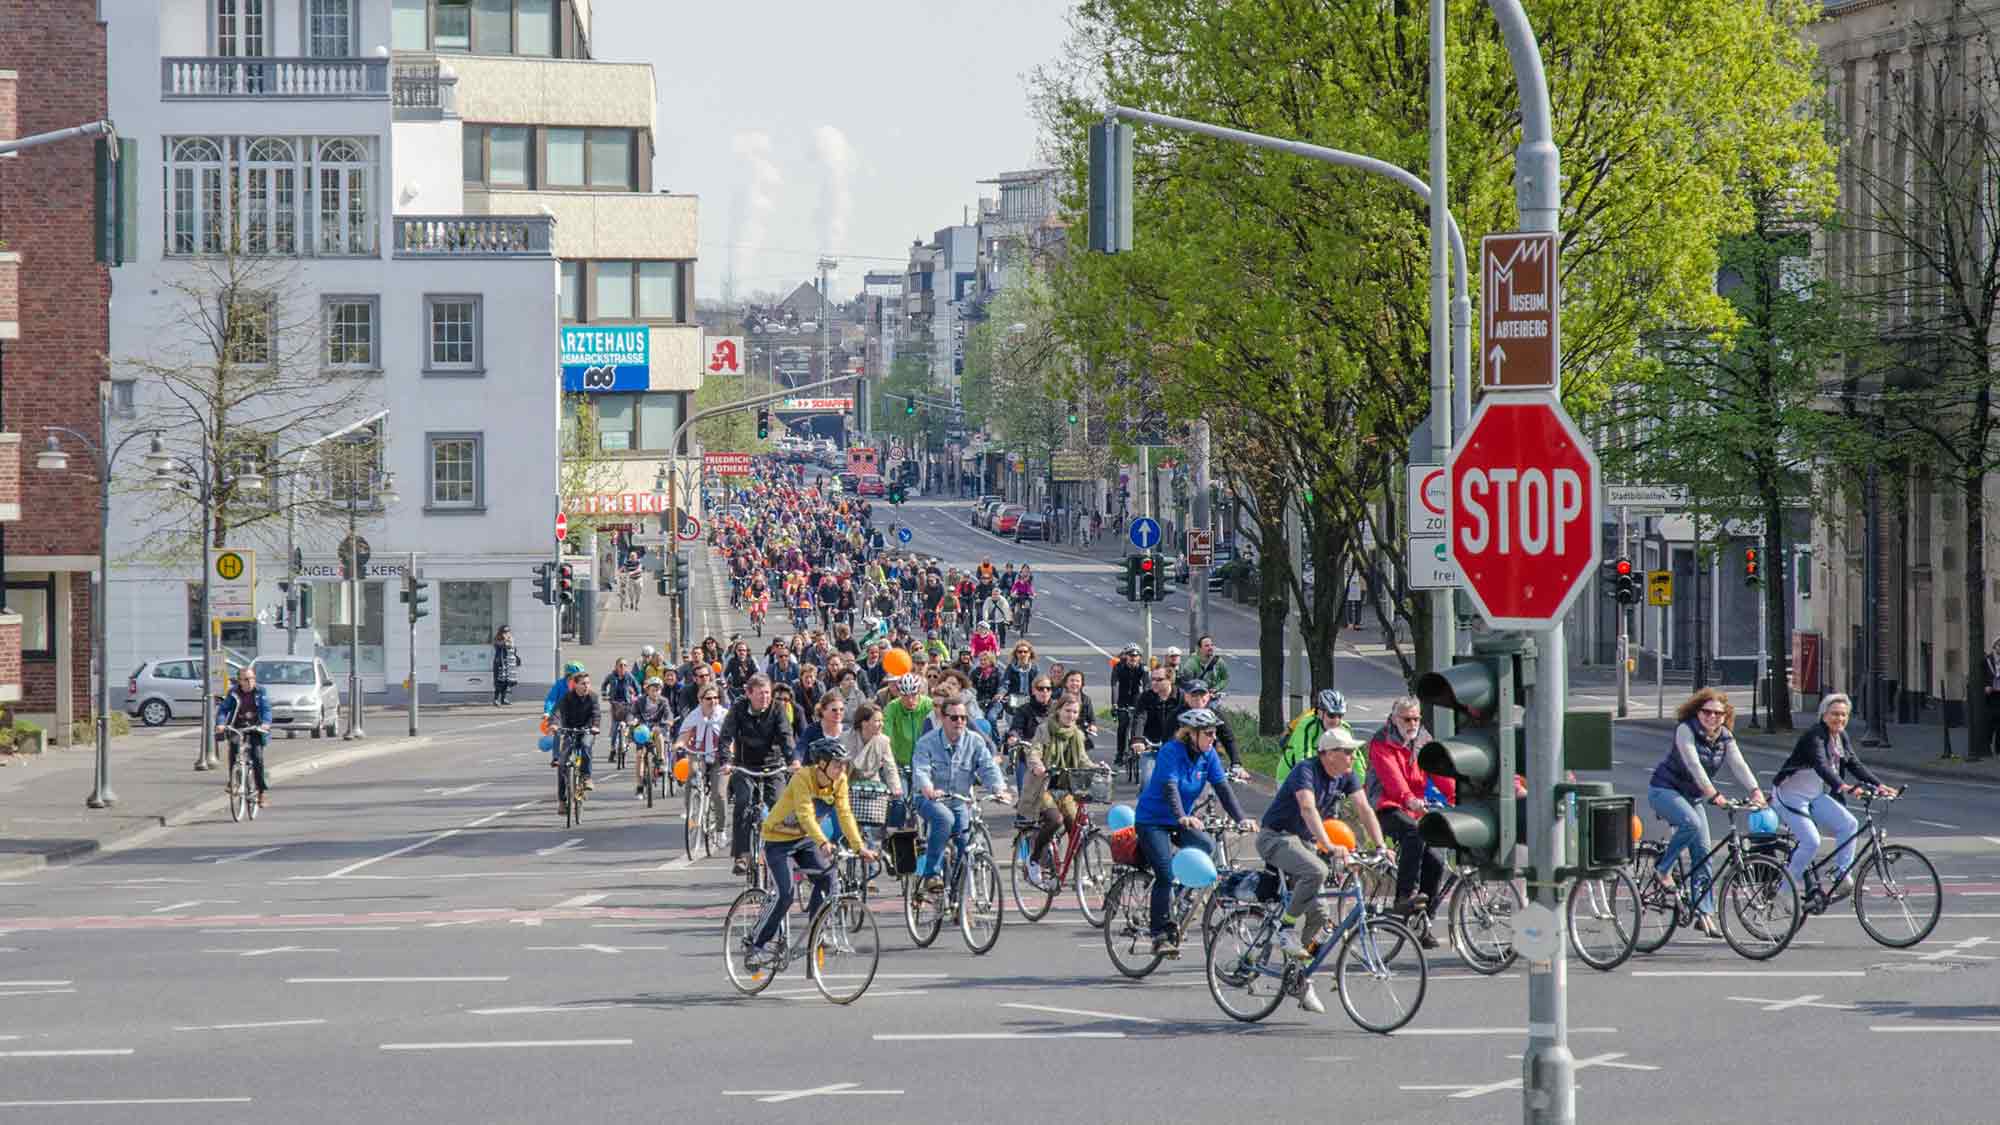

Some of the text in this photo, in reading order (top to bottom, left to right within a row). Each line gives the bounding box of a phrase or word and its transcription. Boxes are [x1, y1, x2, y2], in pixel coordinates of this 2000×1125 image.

[1495, 319, 1548, 338] ABTEIBERG
[561, 352, 645, 364] ISMARCKSTRASSE
[705, 456, 749, 465] FRIEDRICH
[1461, 467, 1582, 556] STOP
[223, 559, 236, 575] H
[1433, 569, 1456, 581] frei
